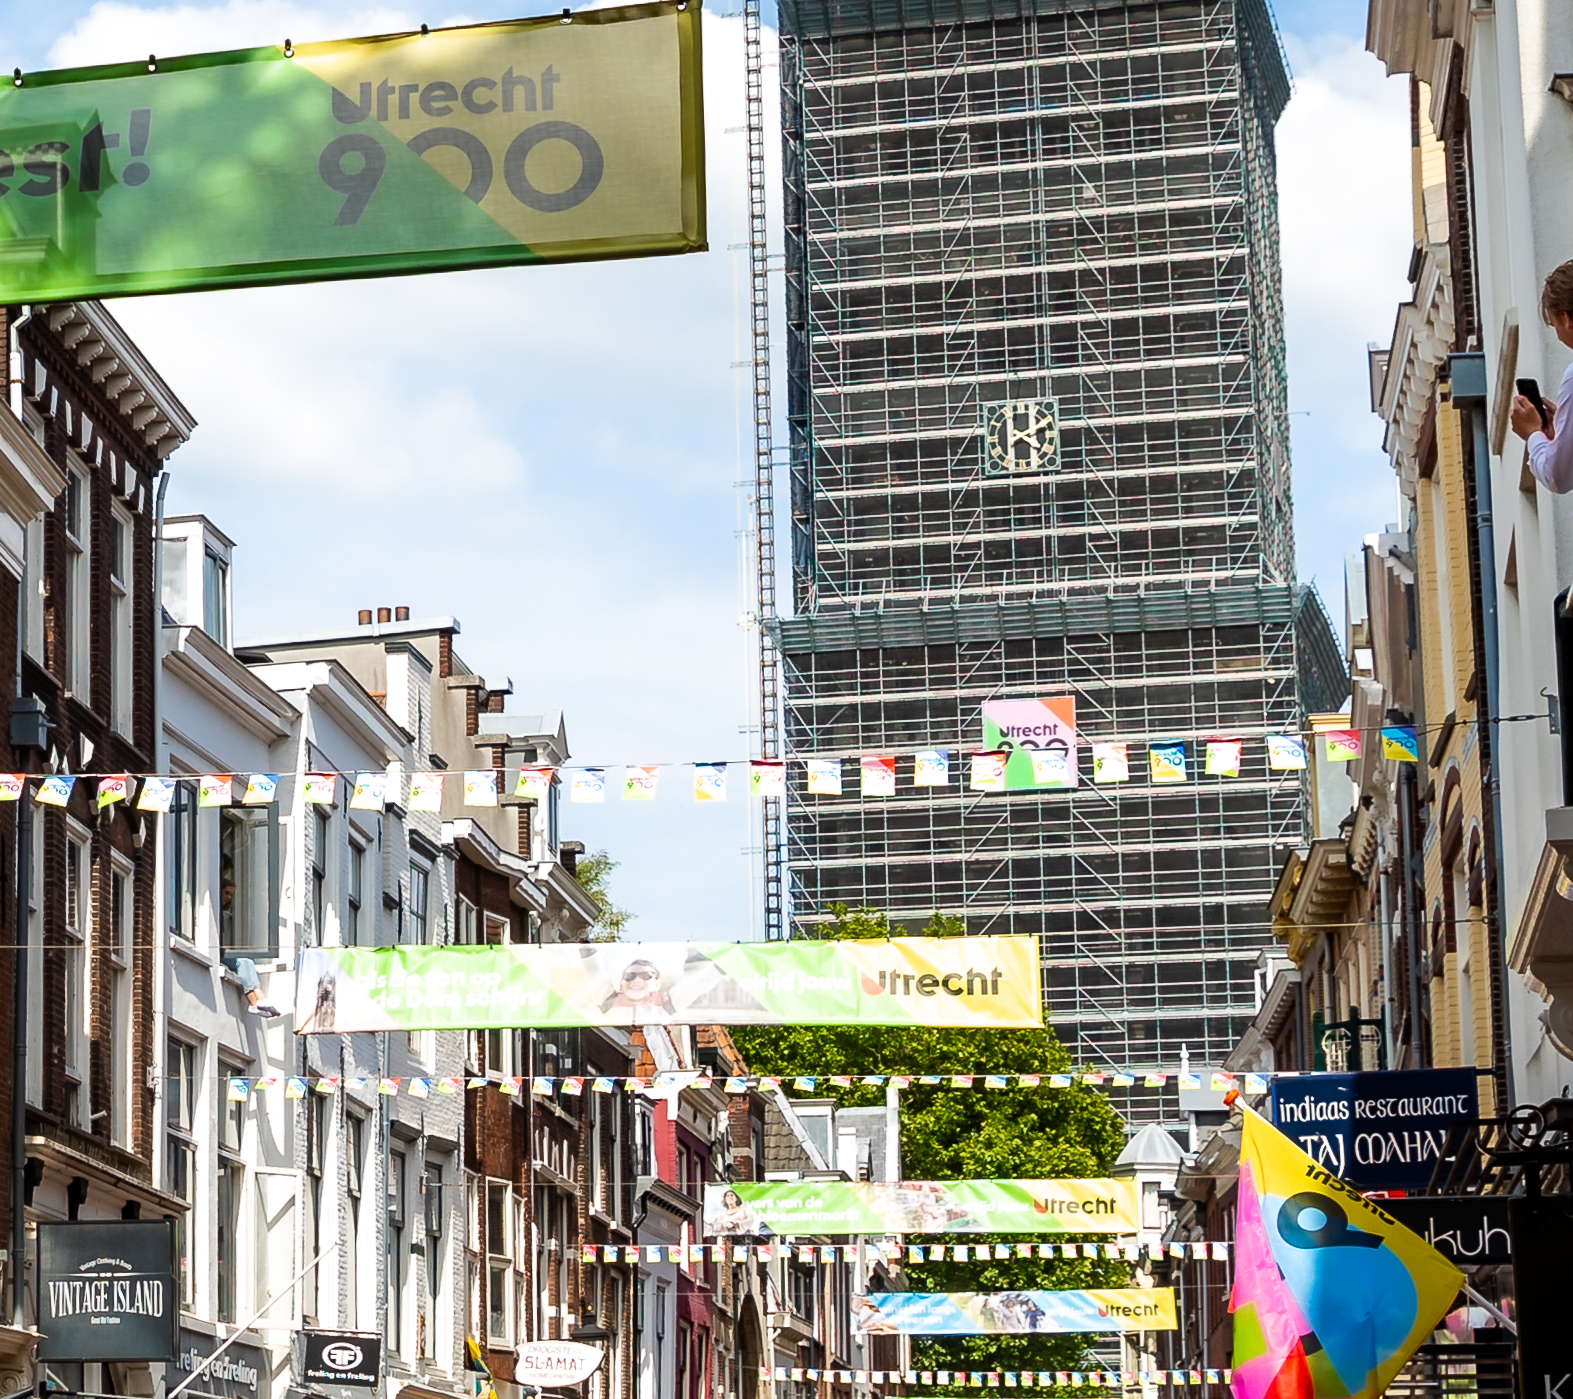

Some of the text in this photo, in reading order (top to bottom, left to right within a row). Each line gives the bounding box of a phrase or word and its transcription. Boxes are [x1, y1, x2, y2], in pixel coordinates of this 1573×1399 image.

[330, 63, 561, 127] Utrecht
[317, 118, 605, 227] 900
[998, 723, 1059, 738] Utrecht
[1385, 737, 1414, 750] 900
[1154, 755, 1183, 767] 900
[860, 965, 1003, 997] Utrecht
[1279, 1095, 1350, 1123] indiaas
[1033, 1197, 1118, 1215] Utrecht
[48, 1280, 164, 1319] VINTAGE ISLAND
[1097, 1302, 1160, 1318] Utrecht
[524, 1355, 586, 1371] SLAMAT
[307, 1370, 335, 1379] freling
[347, 1371, 375, 1382] freling
